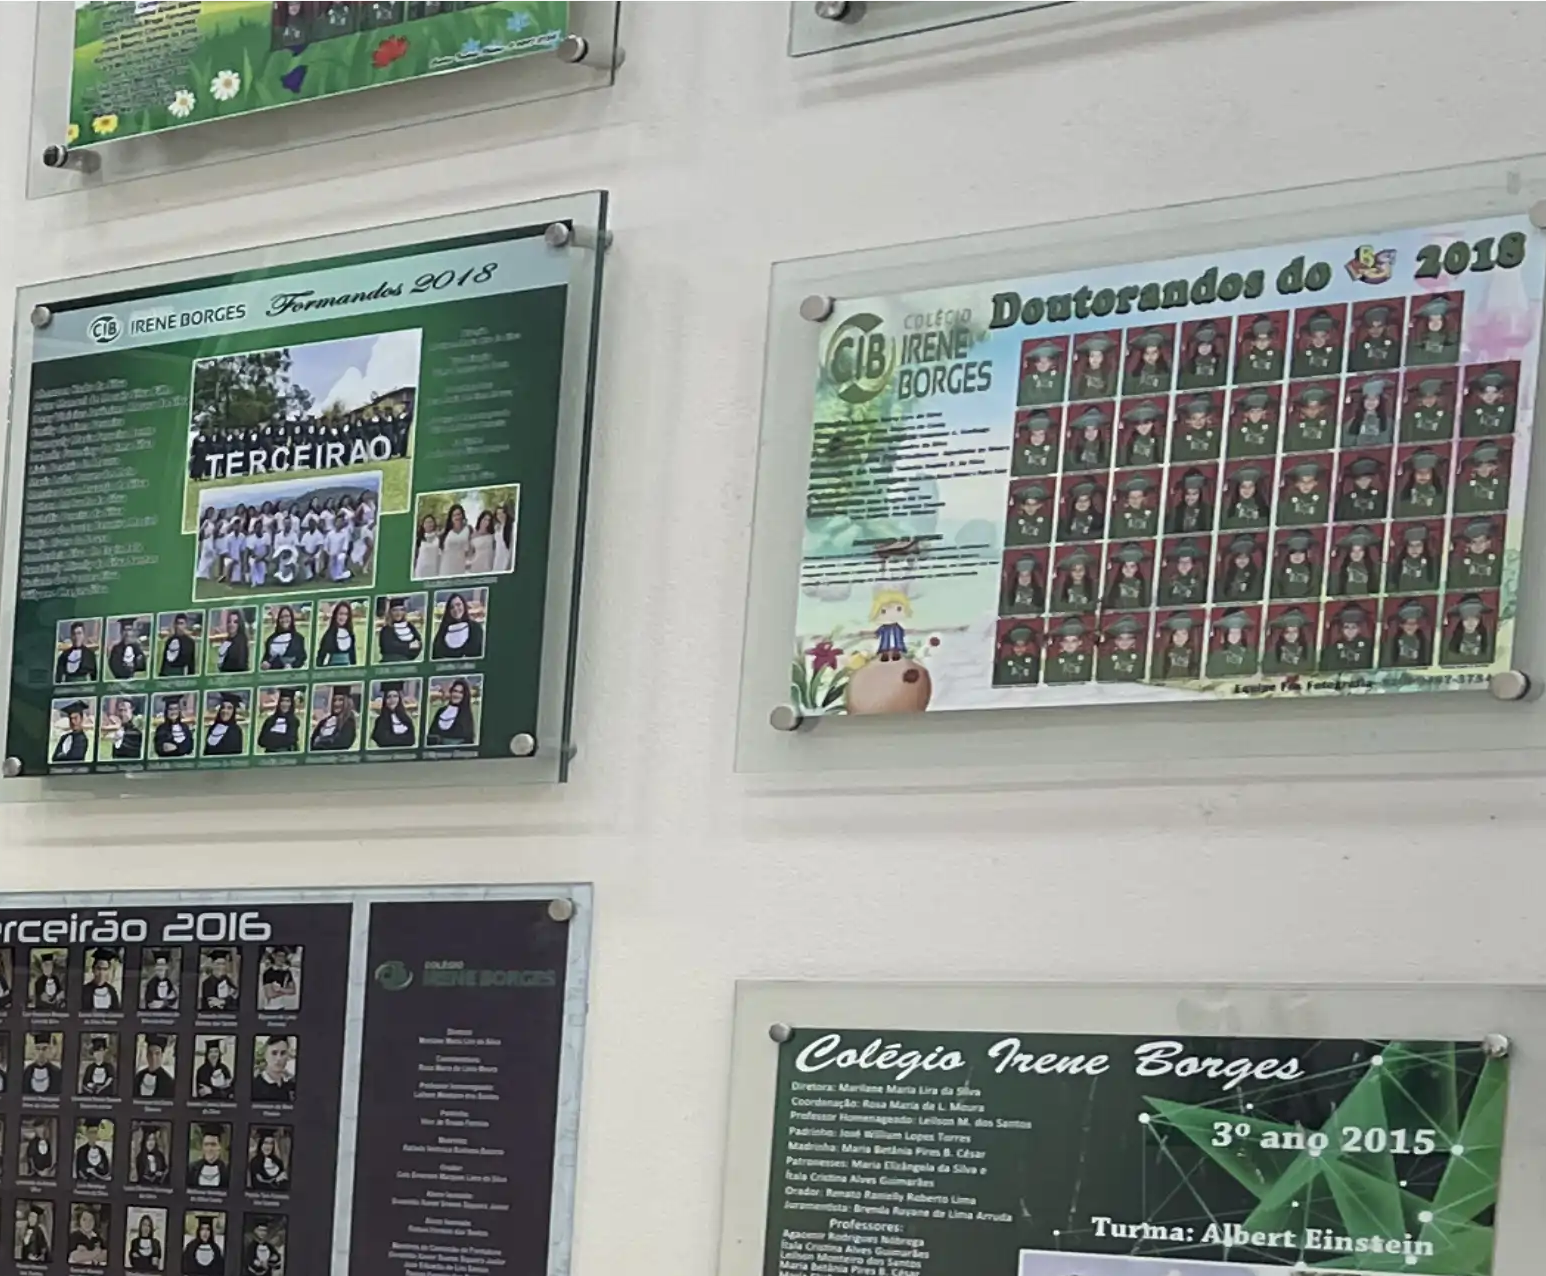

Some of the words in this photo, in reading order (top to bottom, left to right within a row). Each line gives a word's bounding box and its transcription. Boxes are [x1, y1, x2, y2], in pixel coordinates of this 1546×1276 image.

[266, 280, 404, 317] Formandos
[410, 262, 498, 294] 2018
[988, 266, 1266, 330] Doutorandos
[1276, 255, 1332, 295] do
[1415, 231, 1527, 279] 2018
[91, 320, 118, 339] CIB
[130, 315, 177, 334] IRENE
[179, 305, 246, 327] BORGES
[903, 309, 972, 331] COLÉGIO
[901, 330, 970, 361] IRENE
[898, 360, 993, 401] BORGES
[163, 911, 272, 942] 2016
[794, 1033, 967, 1081] Colégio
[987, 1038, 1111, 1076] Irene
[1134, 1040, 1305, 1091] Borges
[791, 1081, 836, 1092] Diretora:
[886, 1084, 916, 1095] Maria
[919, 1086, 938, 1096] Lira
[941, 1086, 954, 1096] da
[957, 1086, 981, 1096] Silva
[790, 1111, 836, 1121] Professor
[919, 1117, 955, 1126] Leilson
[957, 1117, 972, 1127] M.
[975, 1118, 993, 1128] dos
[996, 1119, 1032, 1129] Santos
[863, 1100, 887, 1110] Rosa
[889, 1100, 919, 1111] Maria
[922, 1101, 935, 1111] de
[950, 1102, 985, 1112] Moura
[1211, 1121, 1251, 1147] 3º
[1260, 1129, 1328, 1151] ano
[1342, 1126, 1436, 1155] 2015
[830, 1218, 904, 1232] Professores:
[1091, 1216, 1194, 1243] Turma:
[1202, 1223, 1297, 1248] Albert
[1305, 1228, 1434, 1257] Einstein
